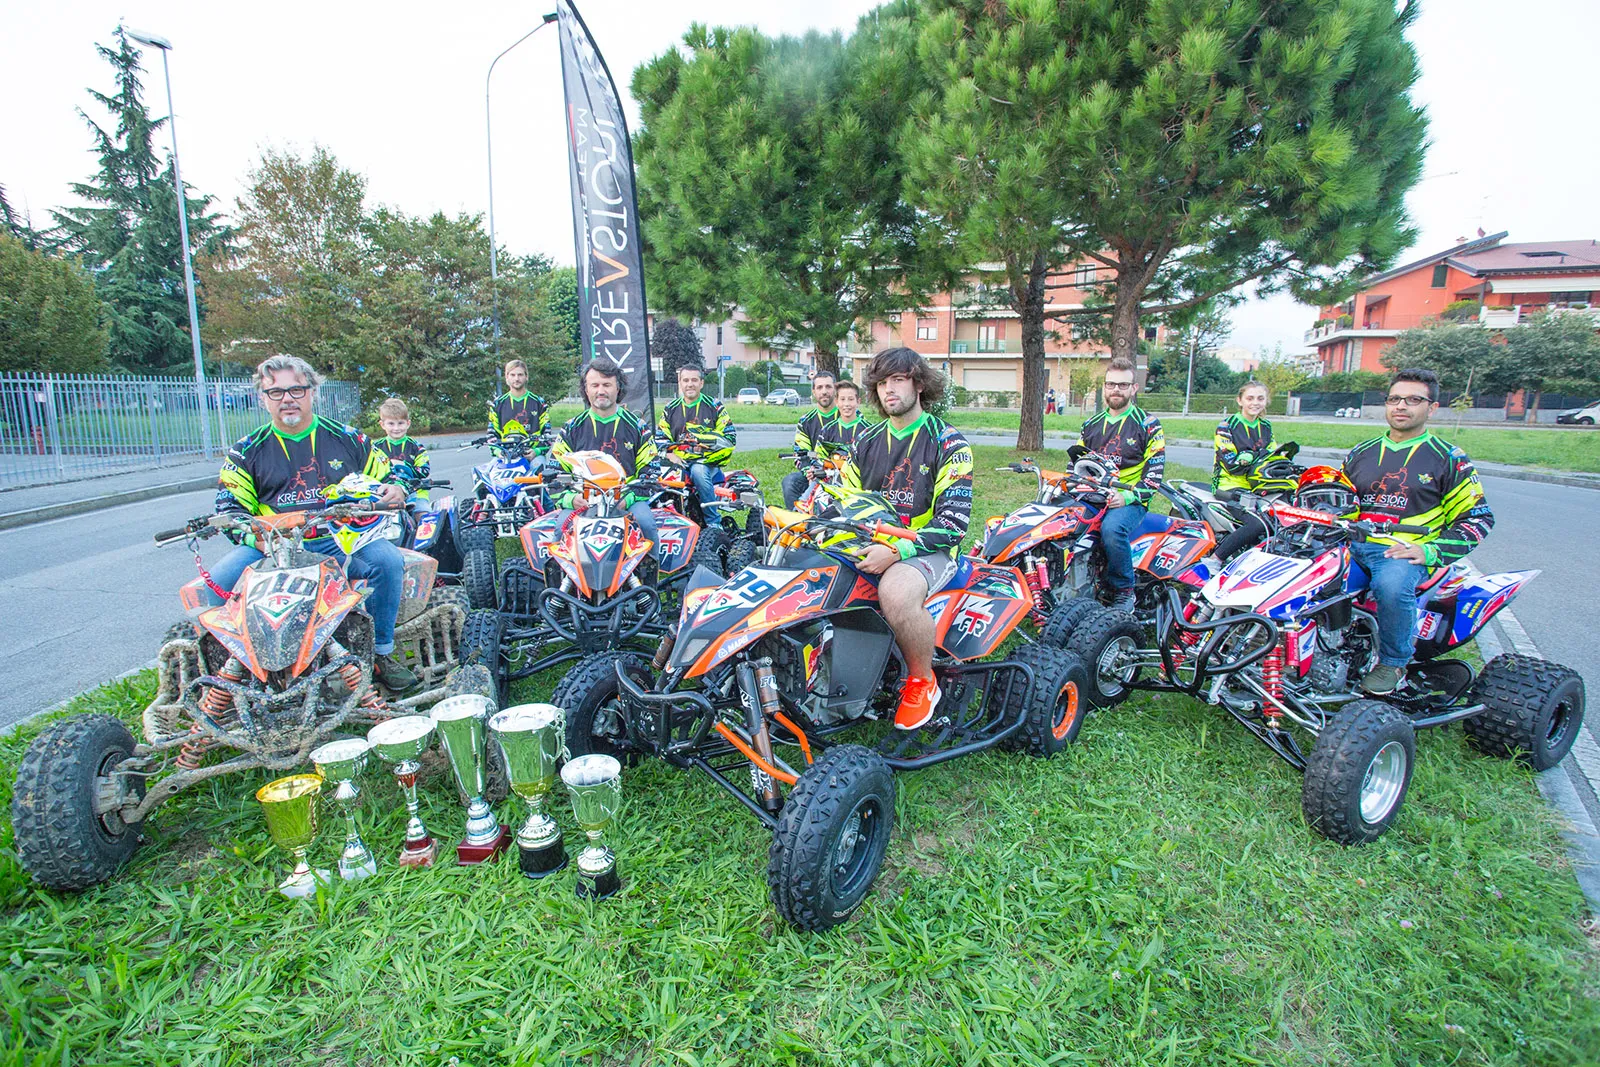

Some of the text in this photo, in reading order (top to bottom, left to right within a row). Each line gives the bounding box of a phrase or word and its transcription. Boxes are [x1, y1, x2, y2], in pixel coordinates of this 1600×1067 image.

[277, 487, 326, 504] KREASTO
[1017, 506, 1046, 518] 7
[1284, 506, 1329, 521] HONDA
[580, 519, 625, 541] 568
[1419, 611, 1435, 639] DWT
[727, 634, 749, 652] MAPEI
